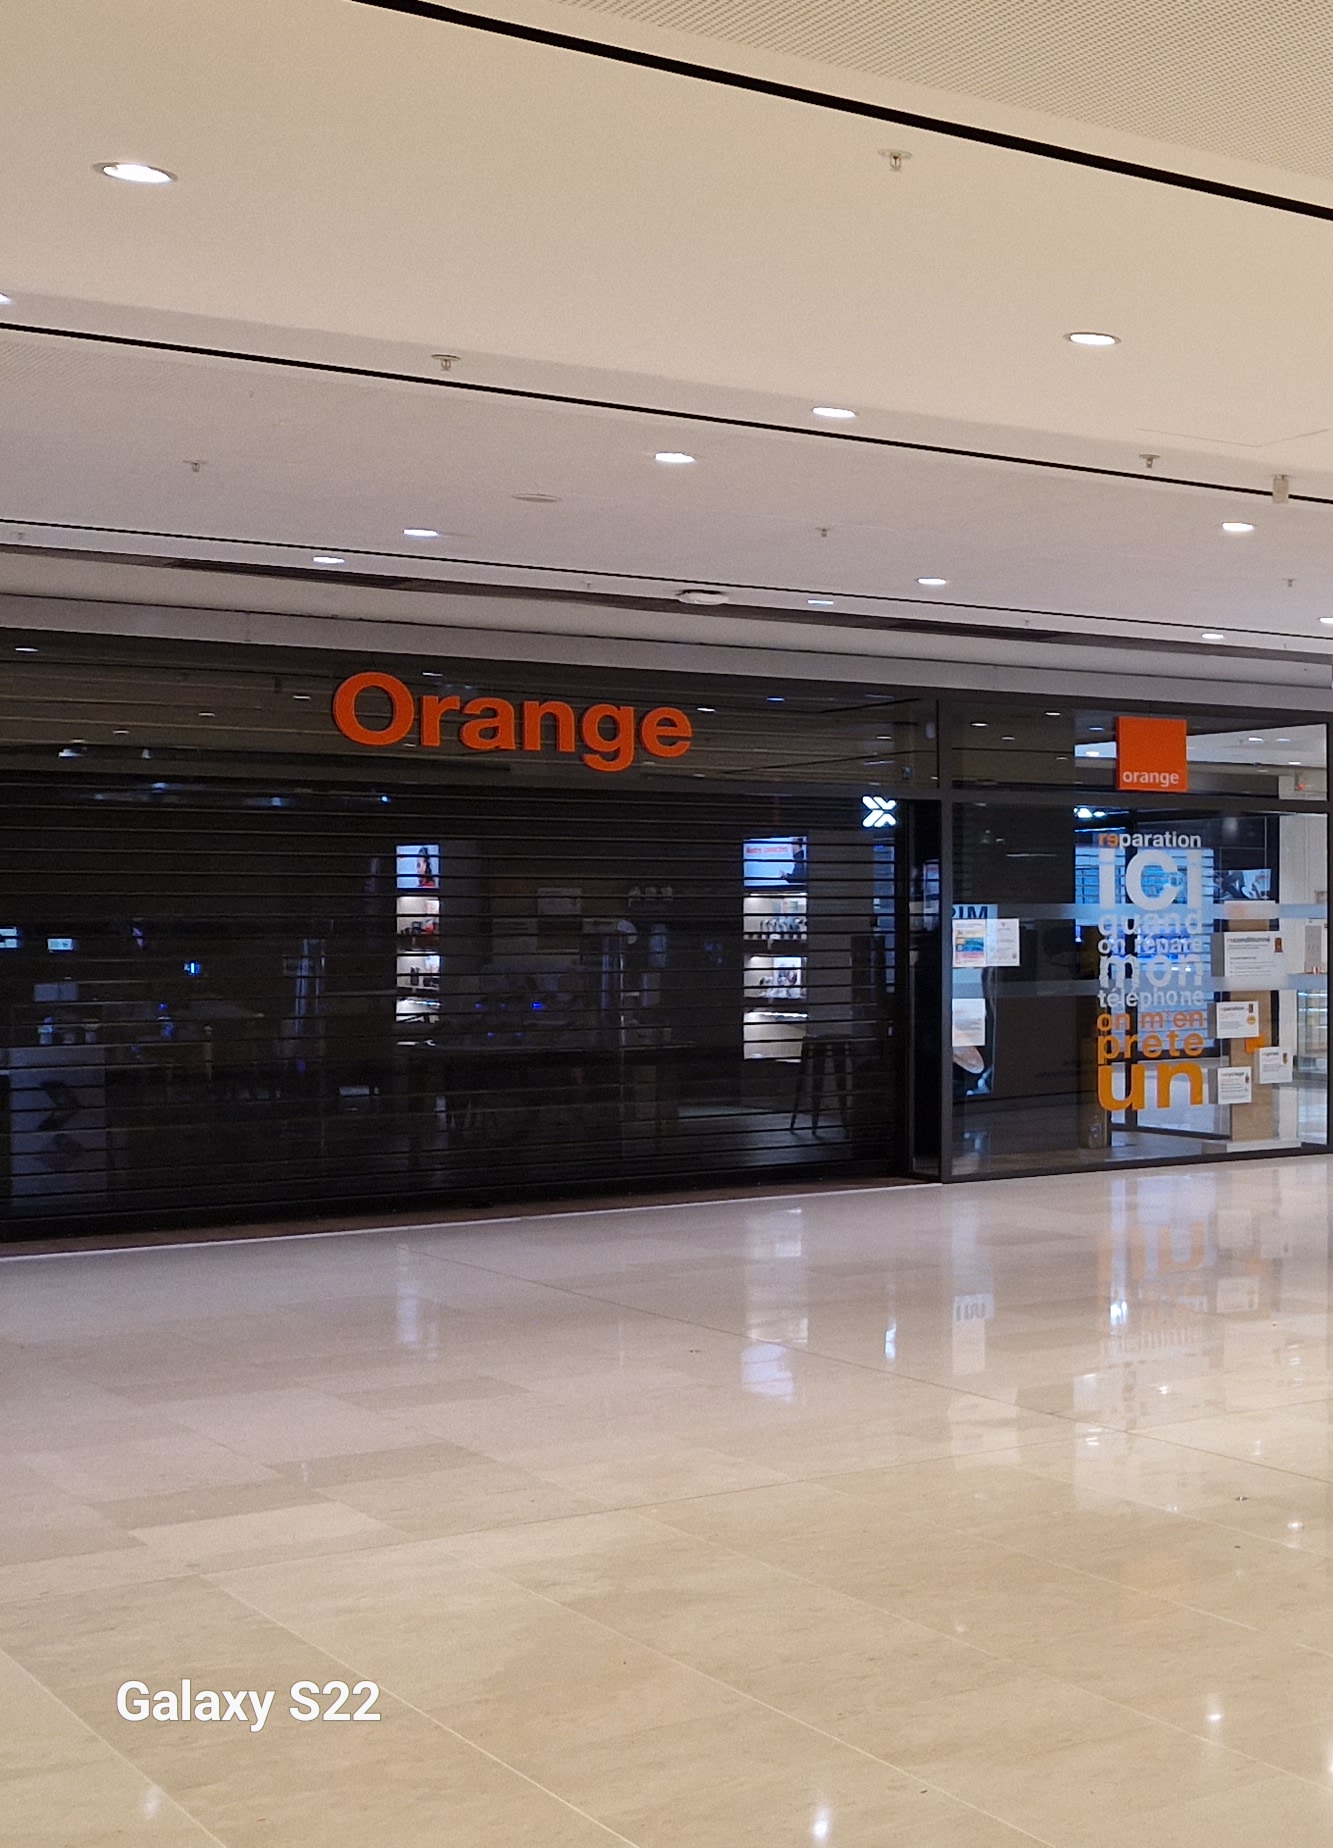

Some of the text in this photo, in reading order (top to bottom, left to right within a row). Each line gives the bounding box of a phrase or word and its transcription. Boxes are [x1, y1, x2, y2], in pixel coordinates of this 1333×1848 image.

[332, 671, 693, 772] Orange
[1122, 771, 1179, 787] orange
[1098, 908, 1202, 939] quand
[1098, 934, 1203, 956] on répare
[1099, 953, 1203, 988] mon
[1097, 987, 1204, 1010] téléphone
[1097, 1012, 1131, 1031] on
[1140, 1010, 1204, 1030] m'en
[1097, 1030, 1204, 1065] prête
[1097, 1061, 1204, 1111] un
